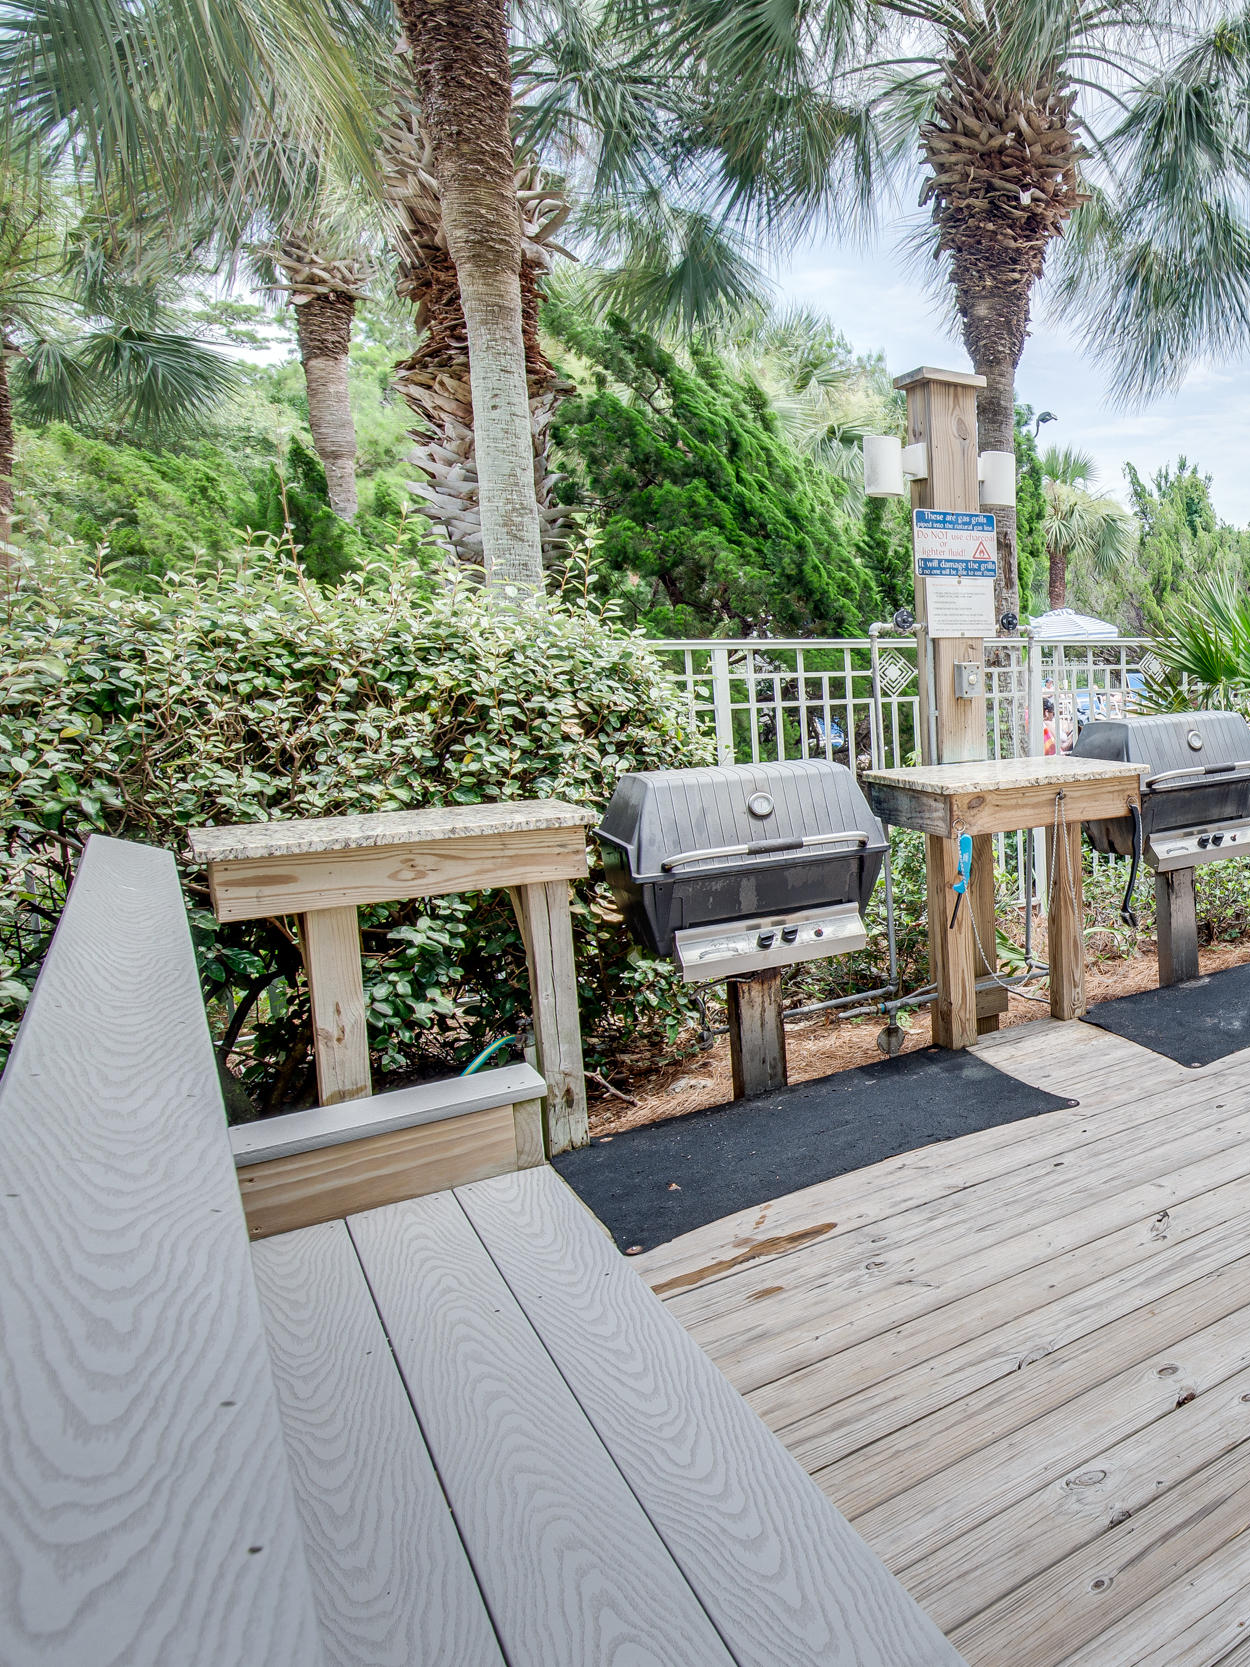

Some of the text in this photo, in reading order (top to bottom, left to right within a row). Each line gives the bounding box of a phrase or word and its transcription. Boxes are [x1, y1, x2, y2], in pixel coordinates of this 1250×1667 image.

[924, 511, 944, 520] These
[972, 516, 987, 524] grills
[916, 530, 928, 540] Do
[930, 530, 948, 540] NOT
[966, 533, 995, 542] charcoal
[922, 547, 946, 558] lighter
[926, 560, 938, 568] will
[940, 560, 966, 570] damage
[968, 561, 978, 569] the
[980, 562, 996, 570] grills
